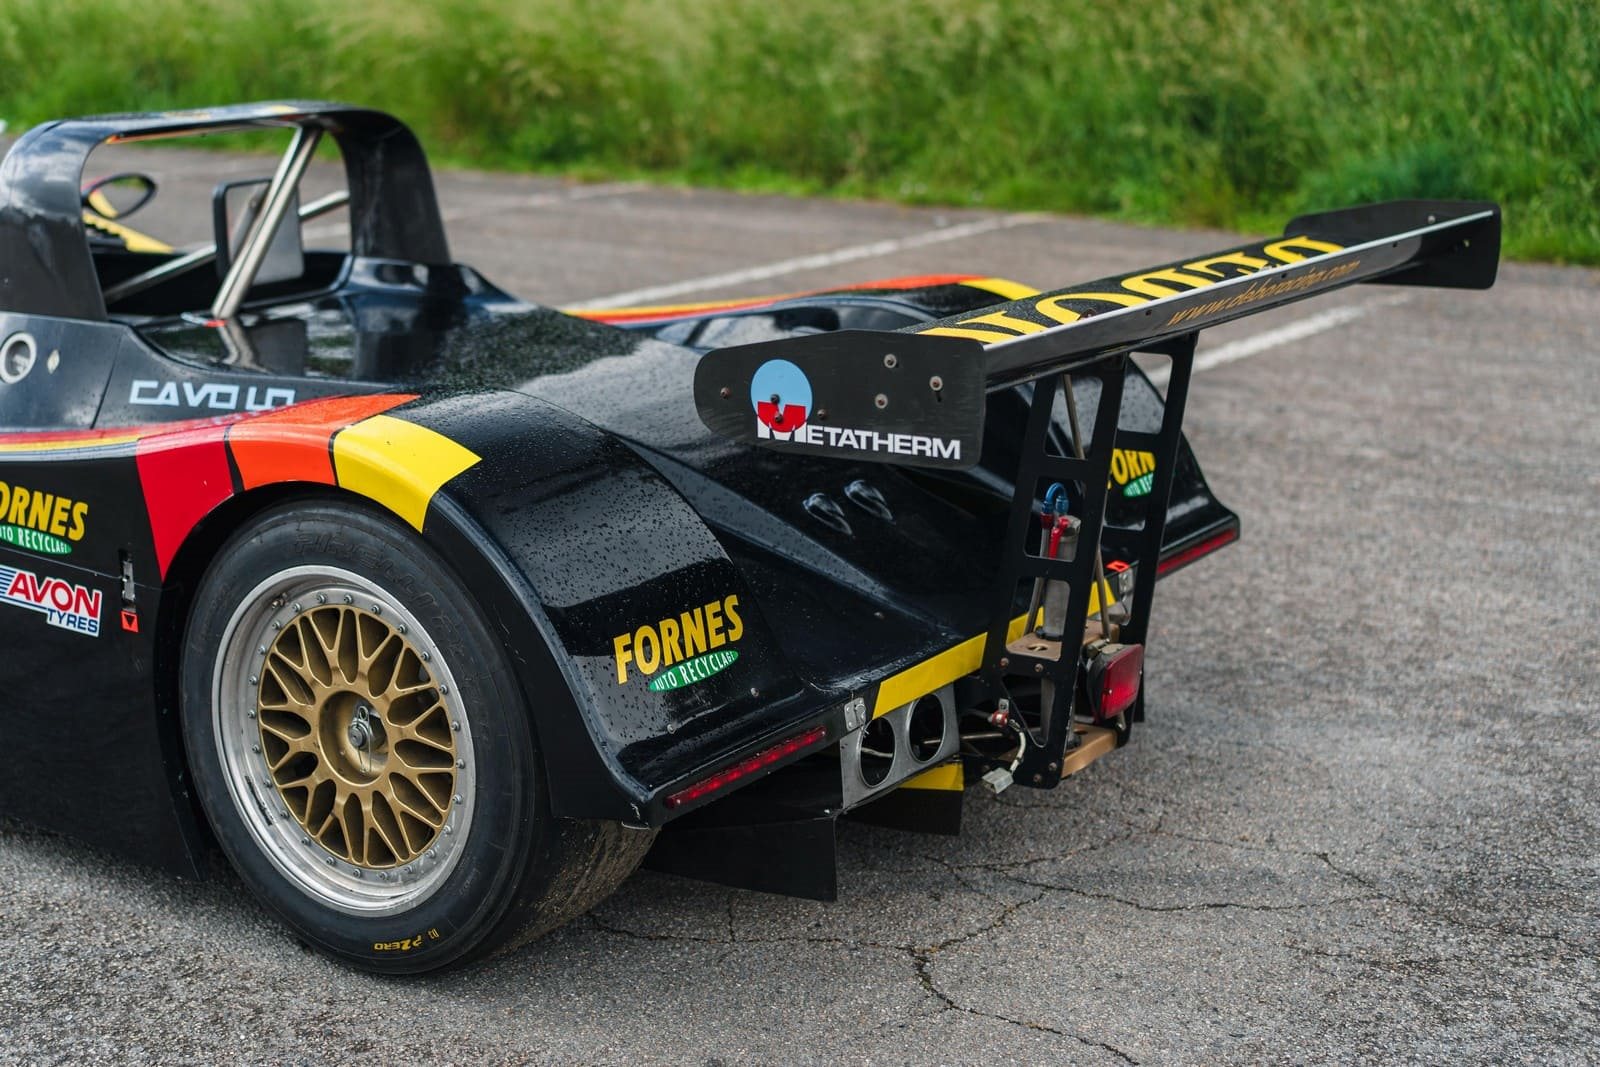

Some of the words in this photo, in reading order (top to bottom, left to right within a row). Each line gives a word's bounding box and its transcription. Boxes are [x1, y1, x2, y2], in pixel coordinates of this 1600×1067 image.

[757, 402, 961, 460] METATHERM
[8, 572, 101, 619] AVON
[47, 608, 98, 633] TYRES
[613, 594, 744, 685] FORNES
[654, 671, 678, 690] AUTO
